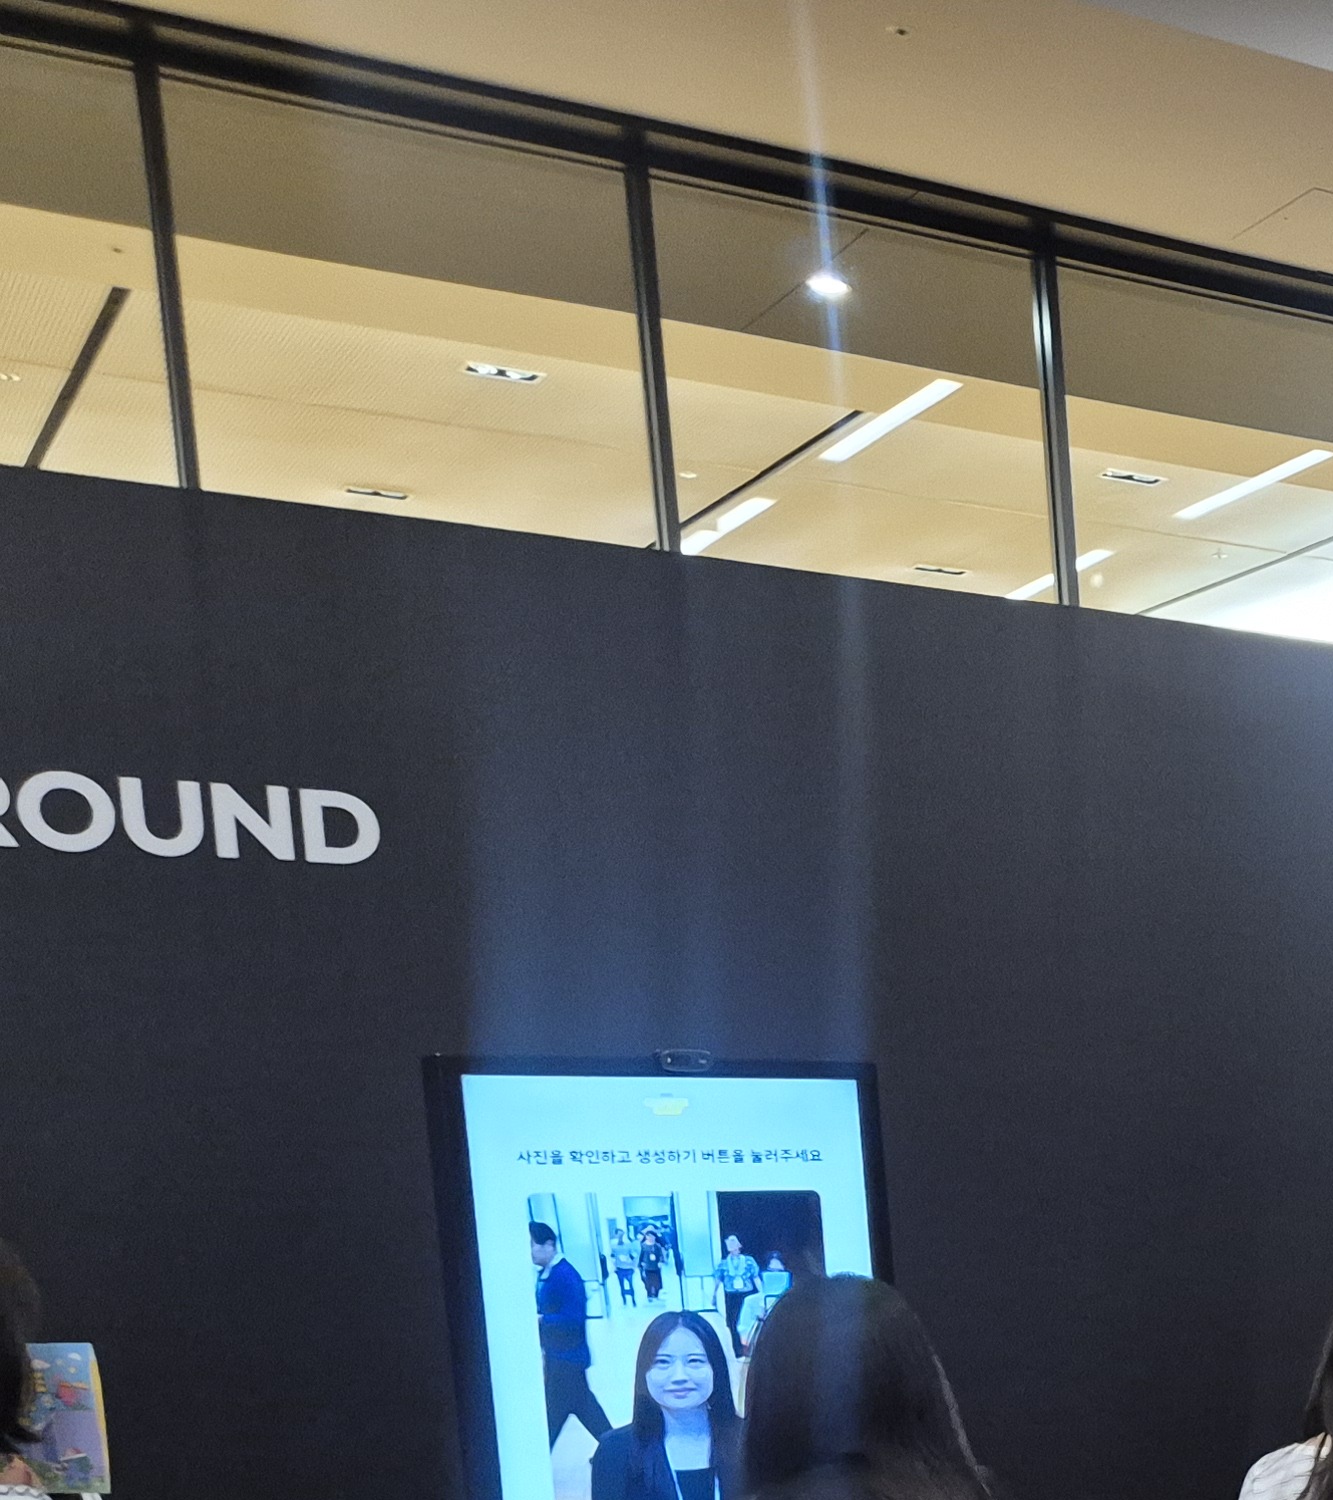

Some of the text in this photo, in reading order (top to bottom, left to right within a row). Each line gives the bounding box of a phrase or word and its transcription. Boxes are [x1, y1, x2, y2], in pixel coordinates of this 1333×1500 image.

[0, 771, 381, 865] OUND
[517, 1149, 824, 1165] 사진을 확인하고 생성하기 버튼을 눌러주세요
